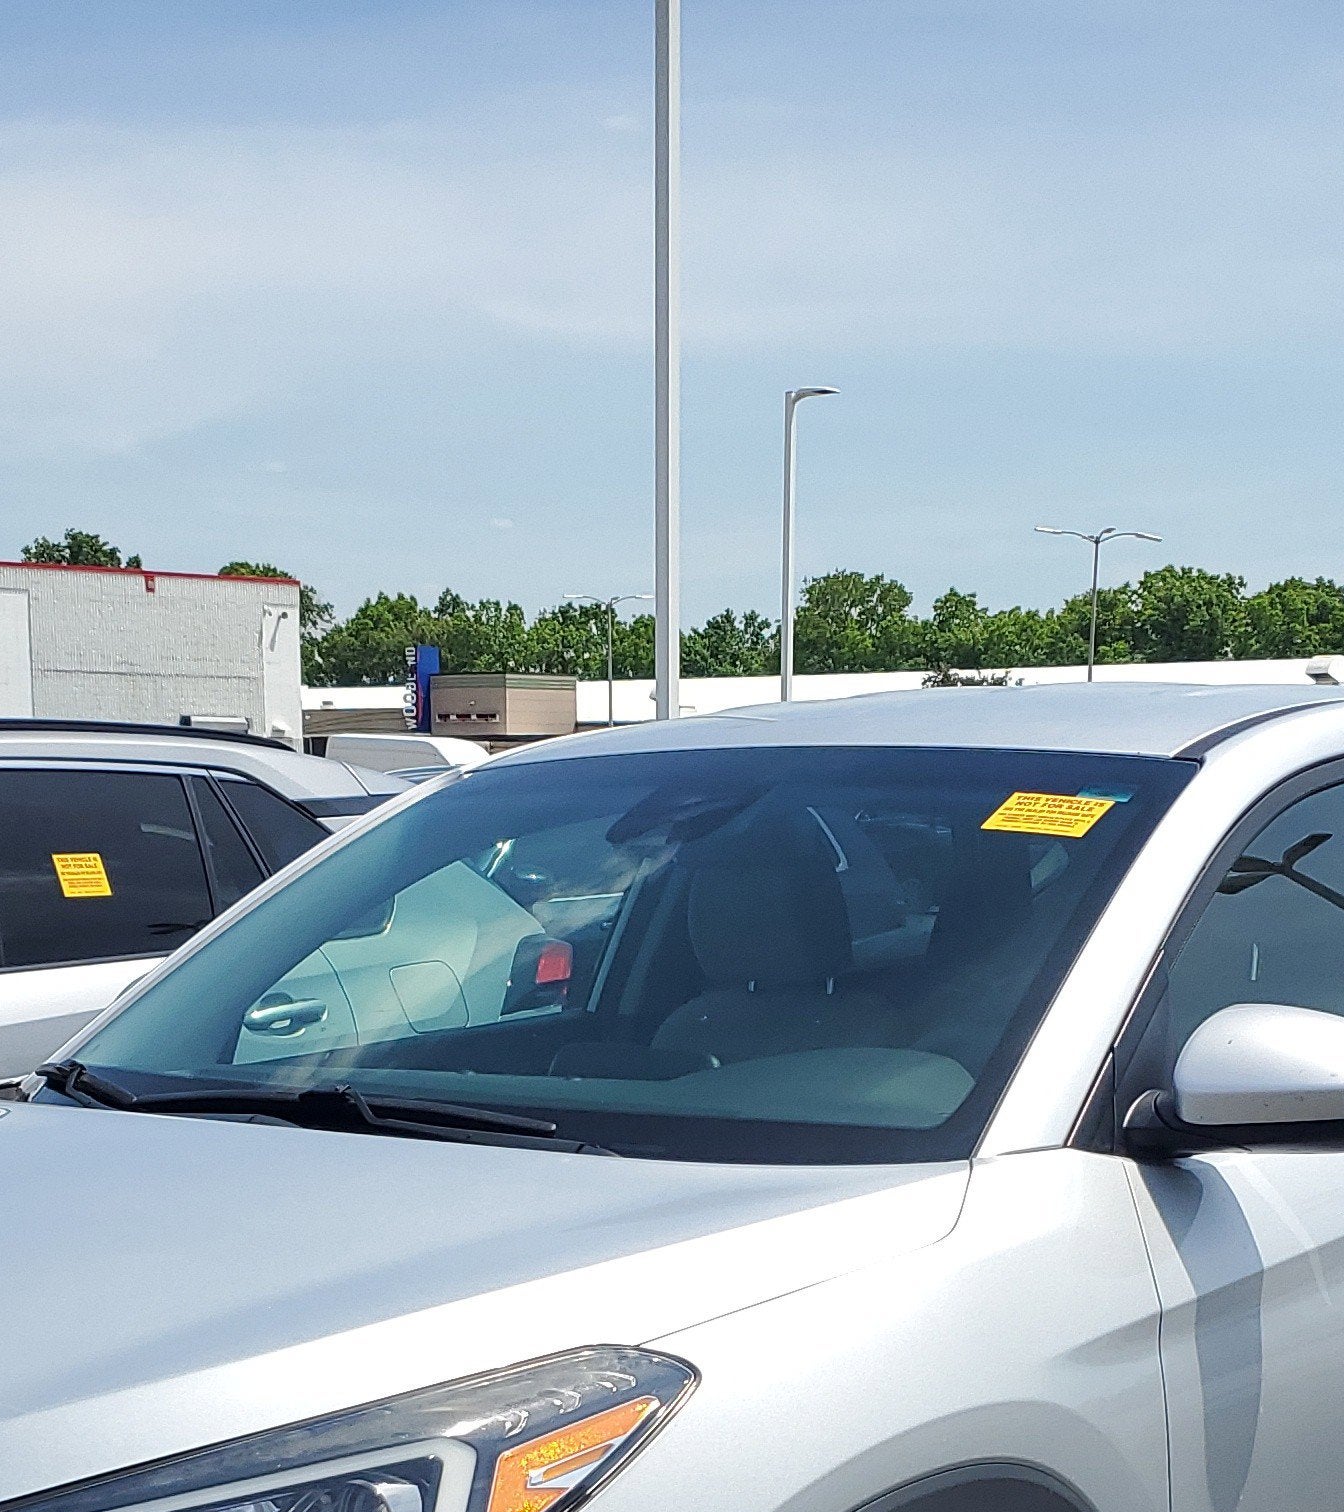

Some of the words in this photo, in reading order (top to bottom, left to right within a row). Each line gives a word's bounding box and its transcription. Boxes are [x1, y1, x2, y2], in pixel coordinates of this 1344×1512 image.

[403, 647, 417, 730] WOODLND
[1045, 797, 1092, 805] VEHICLE
[1065, 804, 1095, 812] SALE
